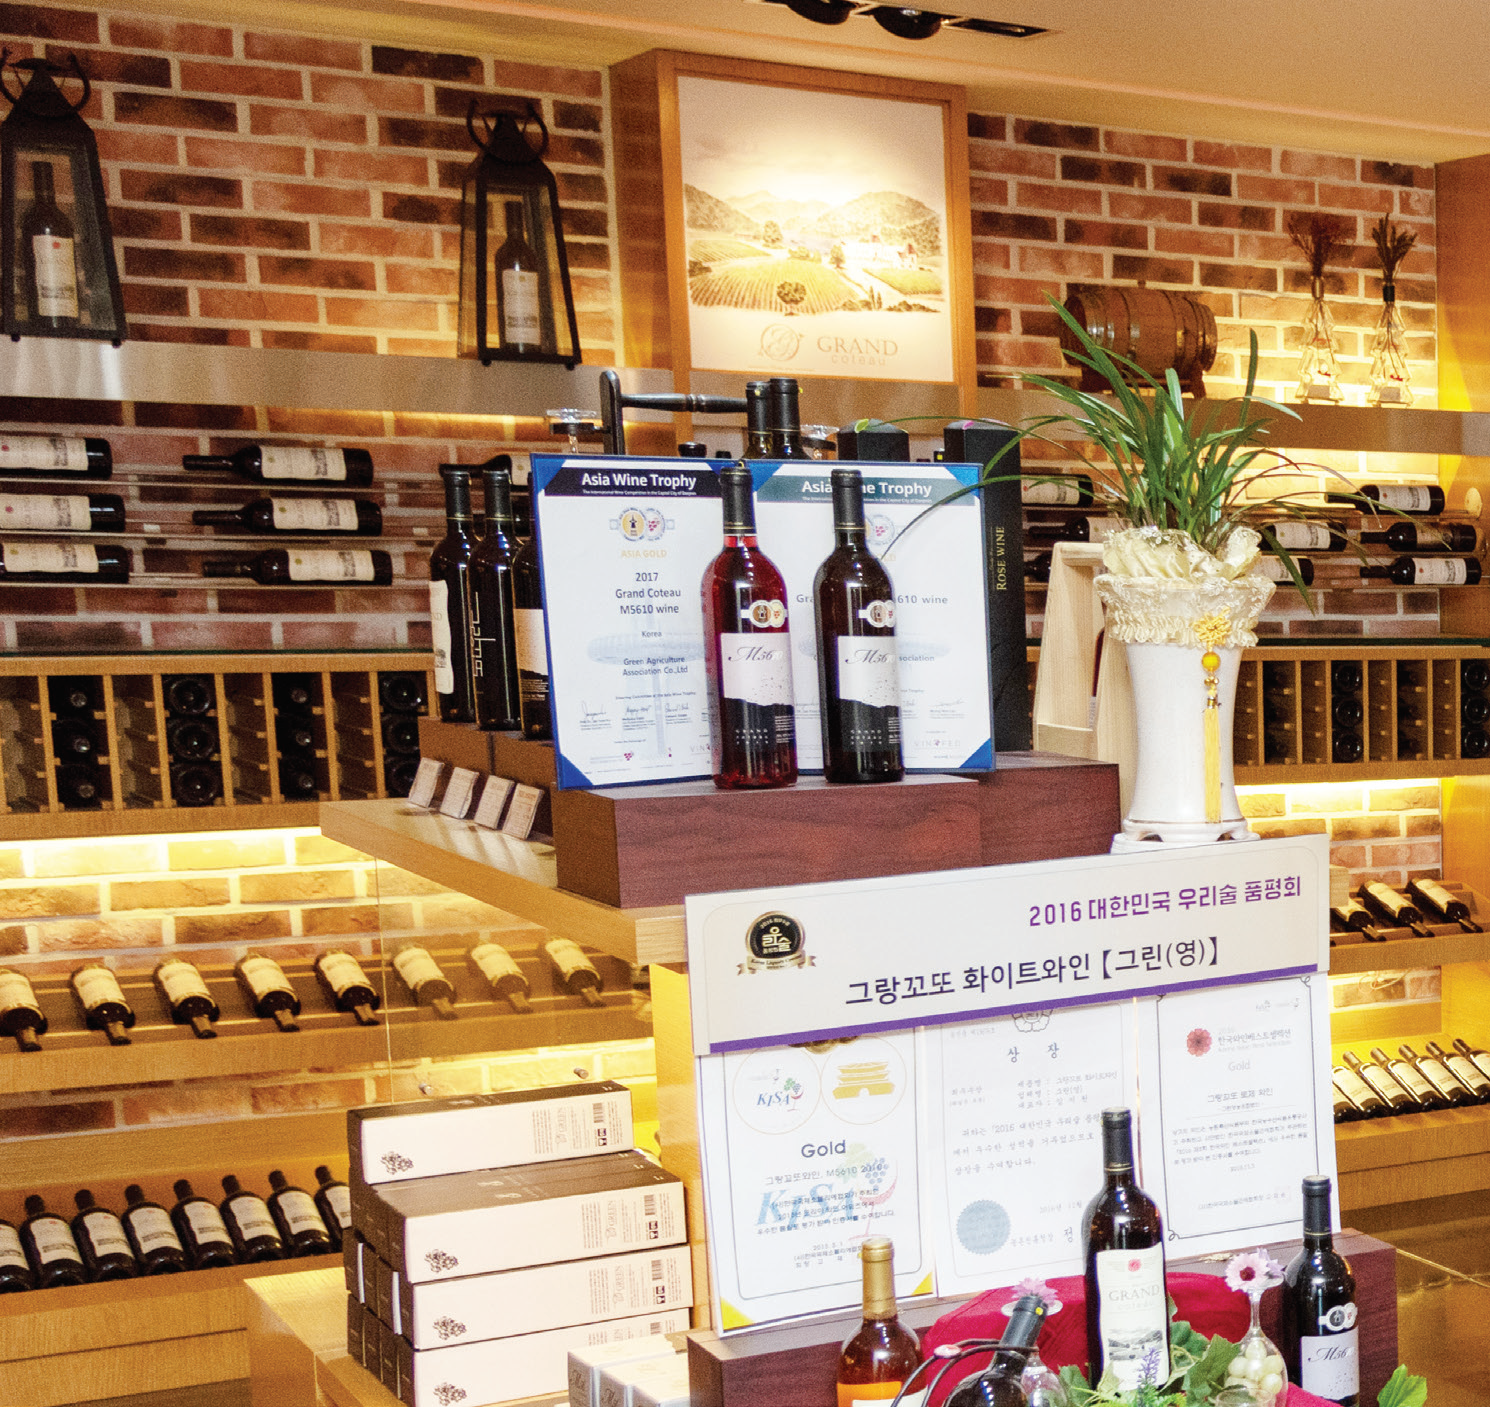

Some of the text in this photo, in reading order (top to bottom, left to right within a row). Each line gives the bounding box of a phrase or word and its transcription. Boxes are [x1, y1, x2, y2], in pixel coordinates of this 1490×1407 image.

[816, 335, 899, 358] GRAND
[581, 472, 697, 490] Asia Wine Trophy
[801, 480, 832, 494] Asia
[878, 482, 932, 498] Trophy
[995, 526, 1008, 591] ROSE WINE
[635, 572, 659, 582] 2017
[615, 587, 681, 599] Grand Coteau
[796, 595, 814, 604] Gra
[921, 595, 949, 605] wine
[620, 604, 680, 615] M5610 wine
[641, 630, 662, 638] Korea
[623, 656, 685, 667] Green Agriculture
[622, 667, 661, 676] Association
[1029, 875, 1302, 928] 2016 대한민국 우리술 품평회
[844, 971, 955, 1007] 그랑꼬또
[962, 951, 1092, 993] 화이트와인
[1007, 1042, 1060, 1063] 상 장
[1228, 1059, 1251, 1072] Gold
[801, 1139, 847, 1159] Gold
[826, 1166, 858, 1177] M5610
[1108, 1283, 1160, 1302] GRAND
